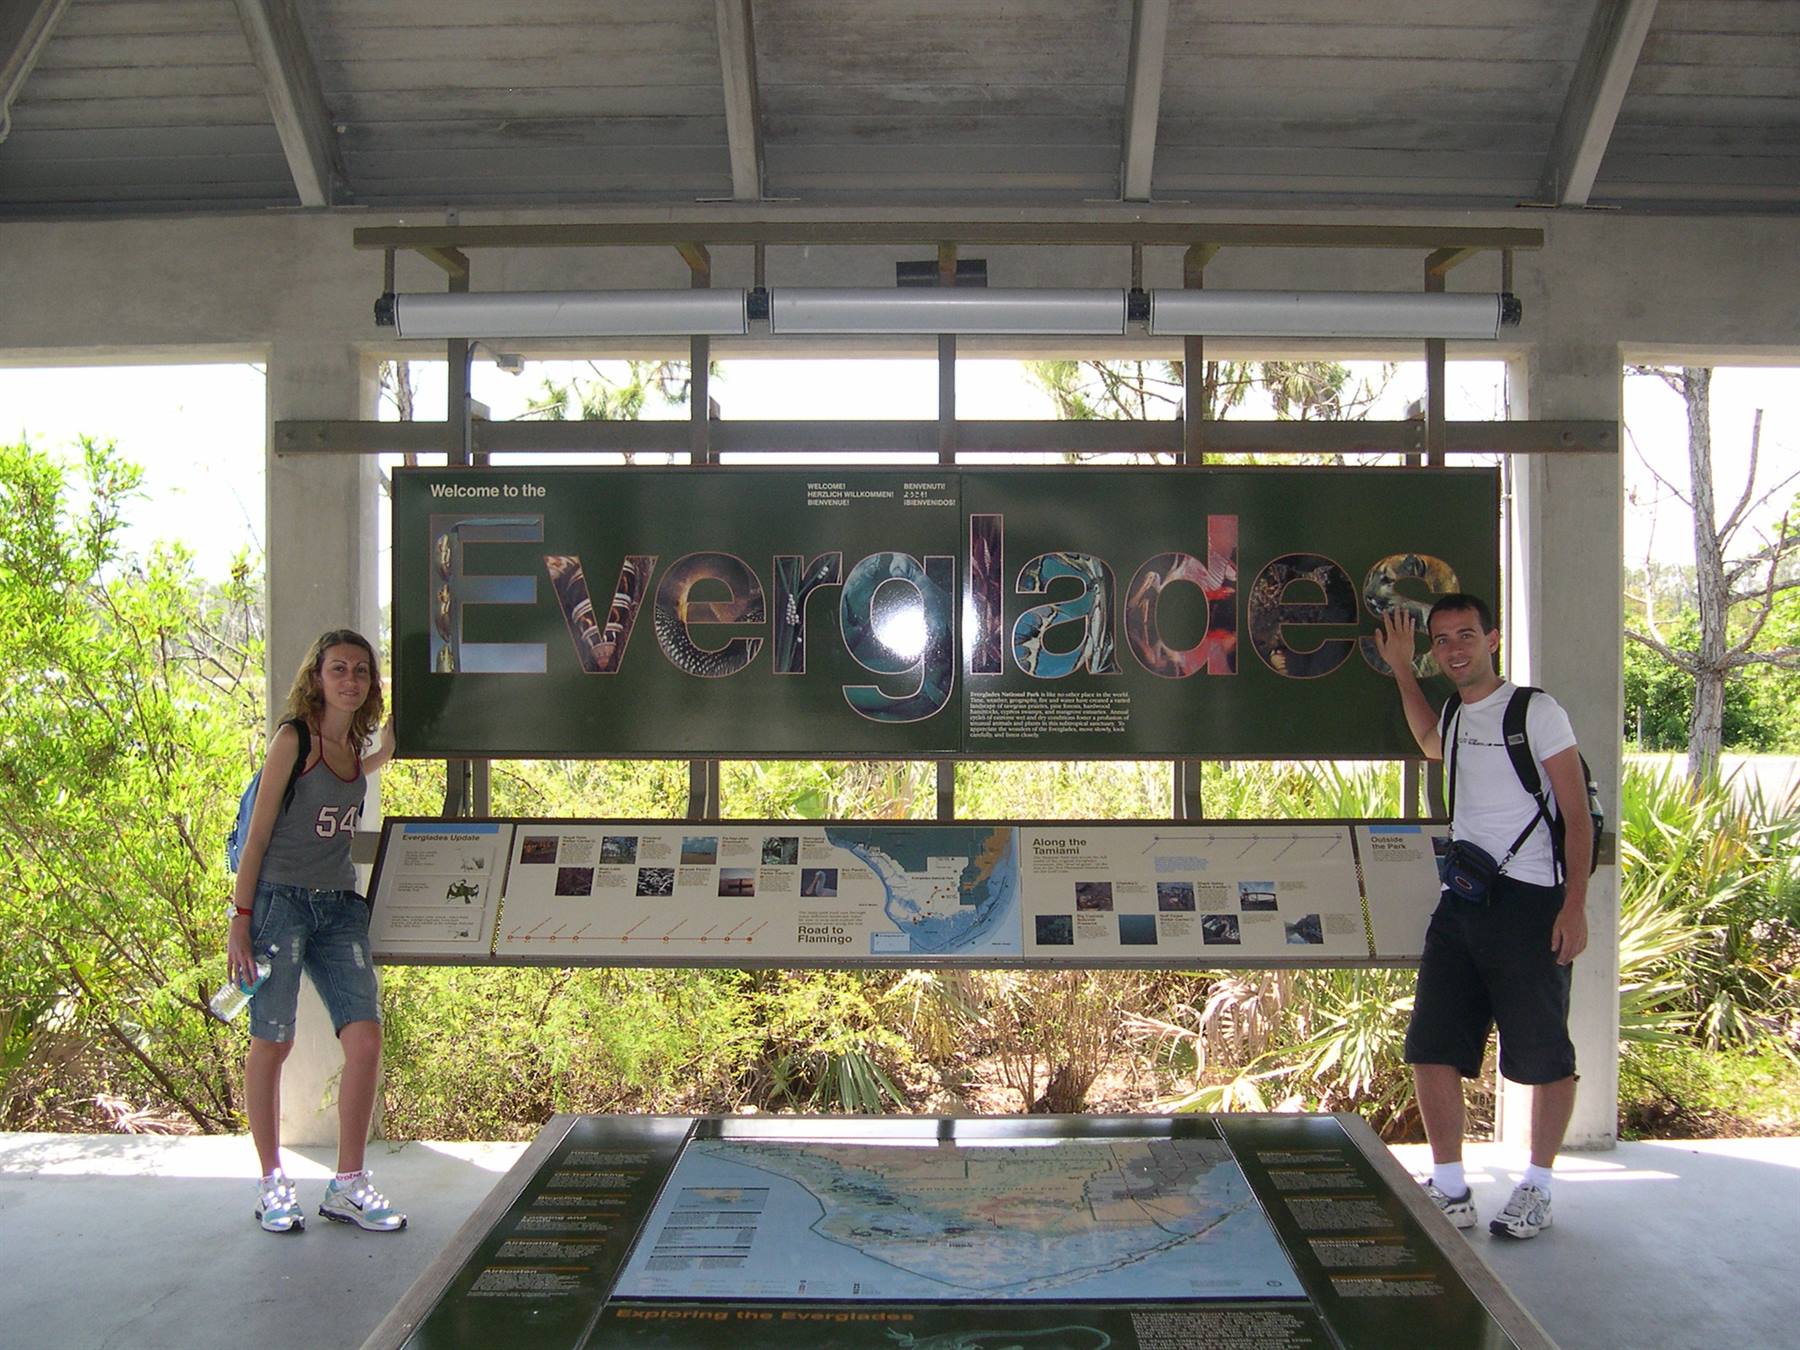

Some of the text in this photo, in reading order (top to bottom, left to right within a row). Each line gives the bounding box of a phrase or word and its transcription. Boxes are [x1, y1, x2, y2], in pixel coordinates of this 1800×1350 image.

[430, 483, 546, 498] Welcome to the
[429, 513, 1462, 724] Everglades
[315, 804, 359, 839] 54
[402, 834, 480, 842] Everglades Update
[1032, 838, 1087, 848] Along the
[1032, 847, 1080, 855] Tamiami
[798, 926, 844, 934] Road to
[798, 934, 853, 945] Flamingo
[615, 1308, 914, 1322] Exploring the Everglades
